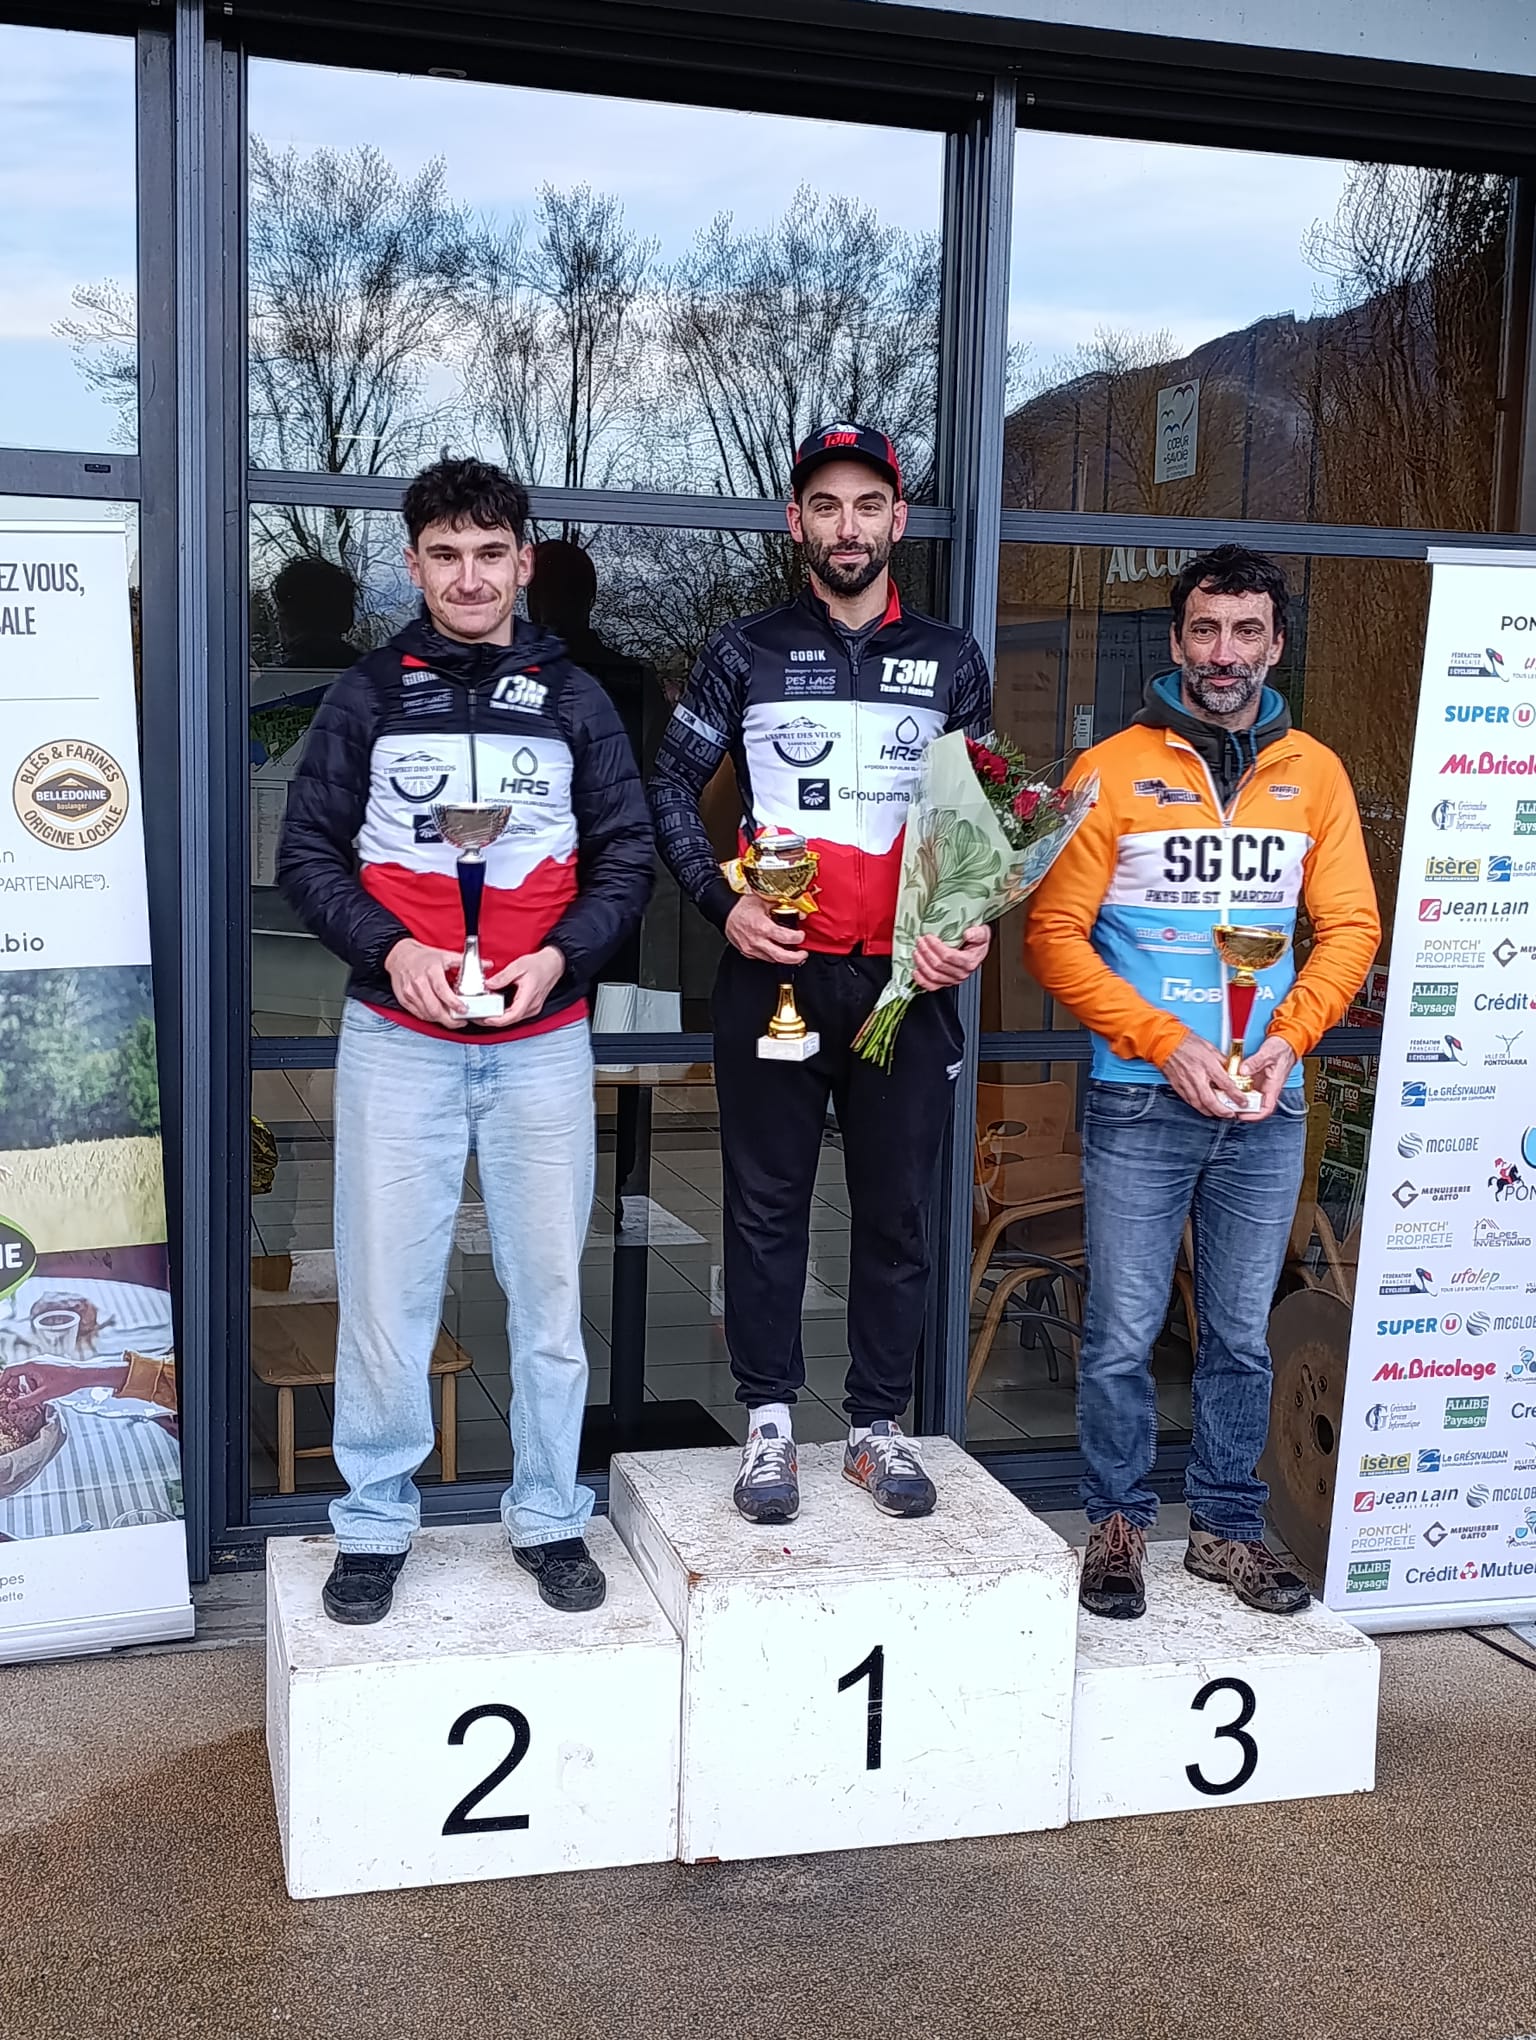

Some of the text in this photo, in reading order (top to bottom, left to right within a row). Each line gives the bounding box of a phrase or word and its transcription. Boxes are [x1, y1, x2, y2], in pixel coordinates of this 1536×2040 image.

[824, 433, 858, 448] T3M
[1106, 546, 1198, 584] ACCU
[22, 563, 85, 597] VOUS,
[0, 606, 37, 635] ALE
[790, 650, 827, 661] GOBIK
[881, 657, 939, 687] T3M
[880, 684, 901, 693] Team
[1444, 705, 1531, 723] SUPER U
[880, 745, 923, 762] HRS
[21, 752, 50, 785] BLÉS
[66, 744, 120, 783] FARINES
[1439, 751, 1536, 775] Mr.Bricol
[35, 789, 108, 801] BELLEDONNE
[500, 777, 550, 797] HRS
[838, 787, 911, 804] Groupama
[24, 804, 123, 846] ORIGINE LOCALE
[1428, 856, 1478, 875] isère
[1443, 901, 1529, 915] Jean Lain
[1415, 952, 1487, 963] PROPRETE
[1413, 984, 1458, 996] ALLIBE
[1410, 1001, 1456, 1016] Paysage
[1474, 993, 1529, 1011] Crédit
[1429, 1084, 1496, 1096] Le GRÉSIVAUDAN
[1421, 1185, 1471, 1195] MENUISERIE
[1431, 1193, 1459, 1201] GATTO
[1386, 1233, 1454, 1246] PROPRETE
[1485, 1231, 1518, 1240] ALPES
[0, 1243, 23, 1270] E
[1376, 1318, 1457, 1336] SUPER U
[1445, 1399, 1489, 1410] ALLIBE
[1443, 1415, 1487, 1428] Paysage
[1363, 1453, 1408, 1470] isère
[1442, 1450, 1508, 1462] Le GRÉSIVAUDAN
[1376, 1488, 1458, 1505] Jean Lain
[1450, 1524, 1499, 1534] MENUISERIE
[1460, 1532, 1487, 1540] GATTO
[1351, 1534, 1417, 1549] PROPRETE
[1349, 1561, 1390, 1574] ALLIBE
[1405, 1565, 1459, 1584] Crédit
[1346, 1579, 1388, 1591] Paysage
[837, 1644, 884, 1770] 1
[1184, 1677, 1259, 1796] 3
[441, 1703, 532, 1836] 2
